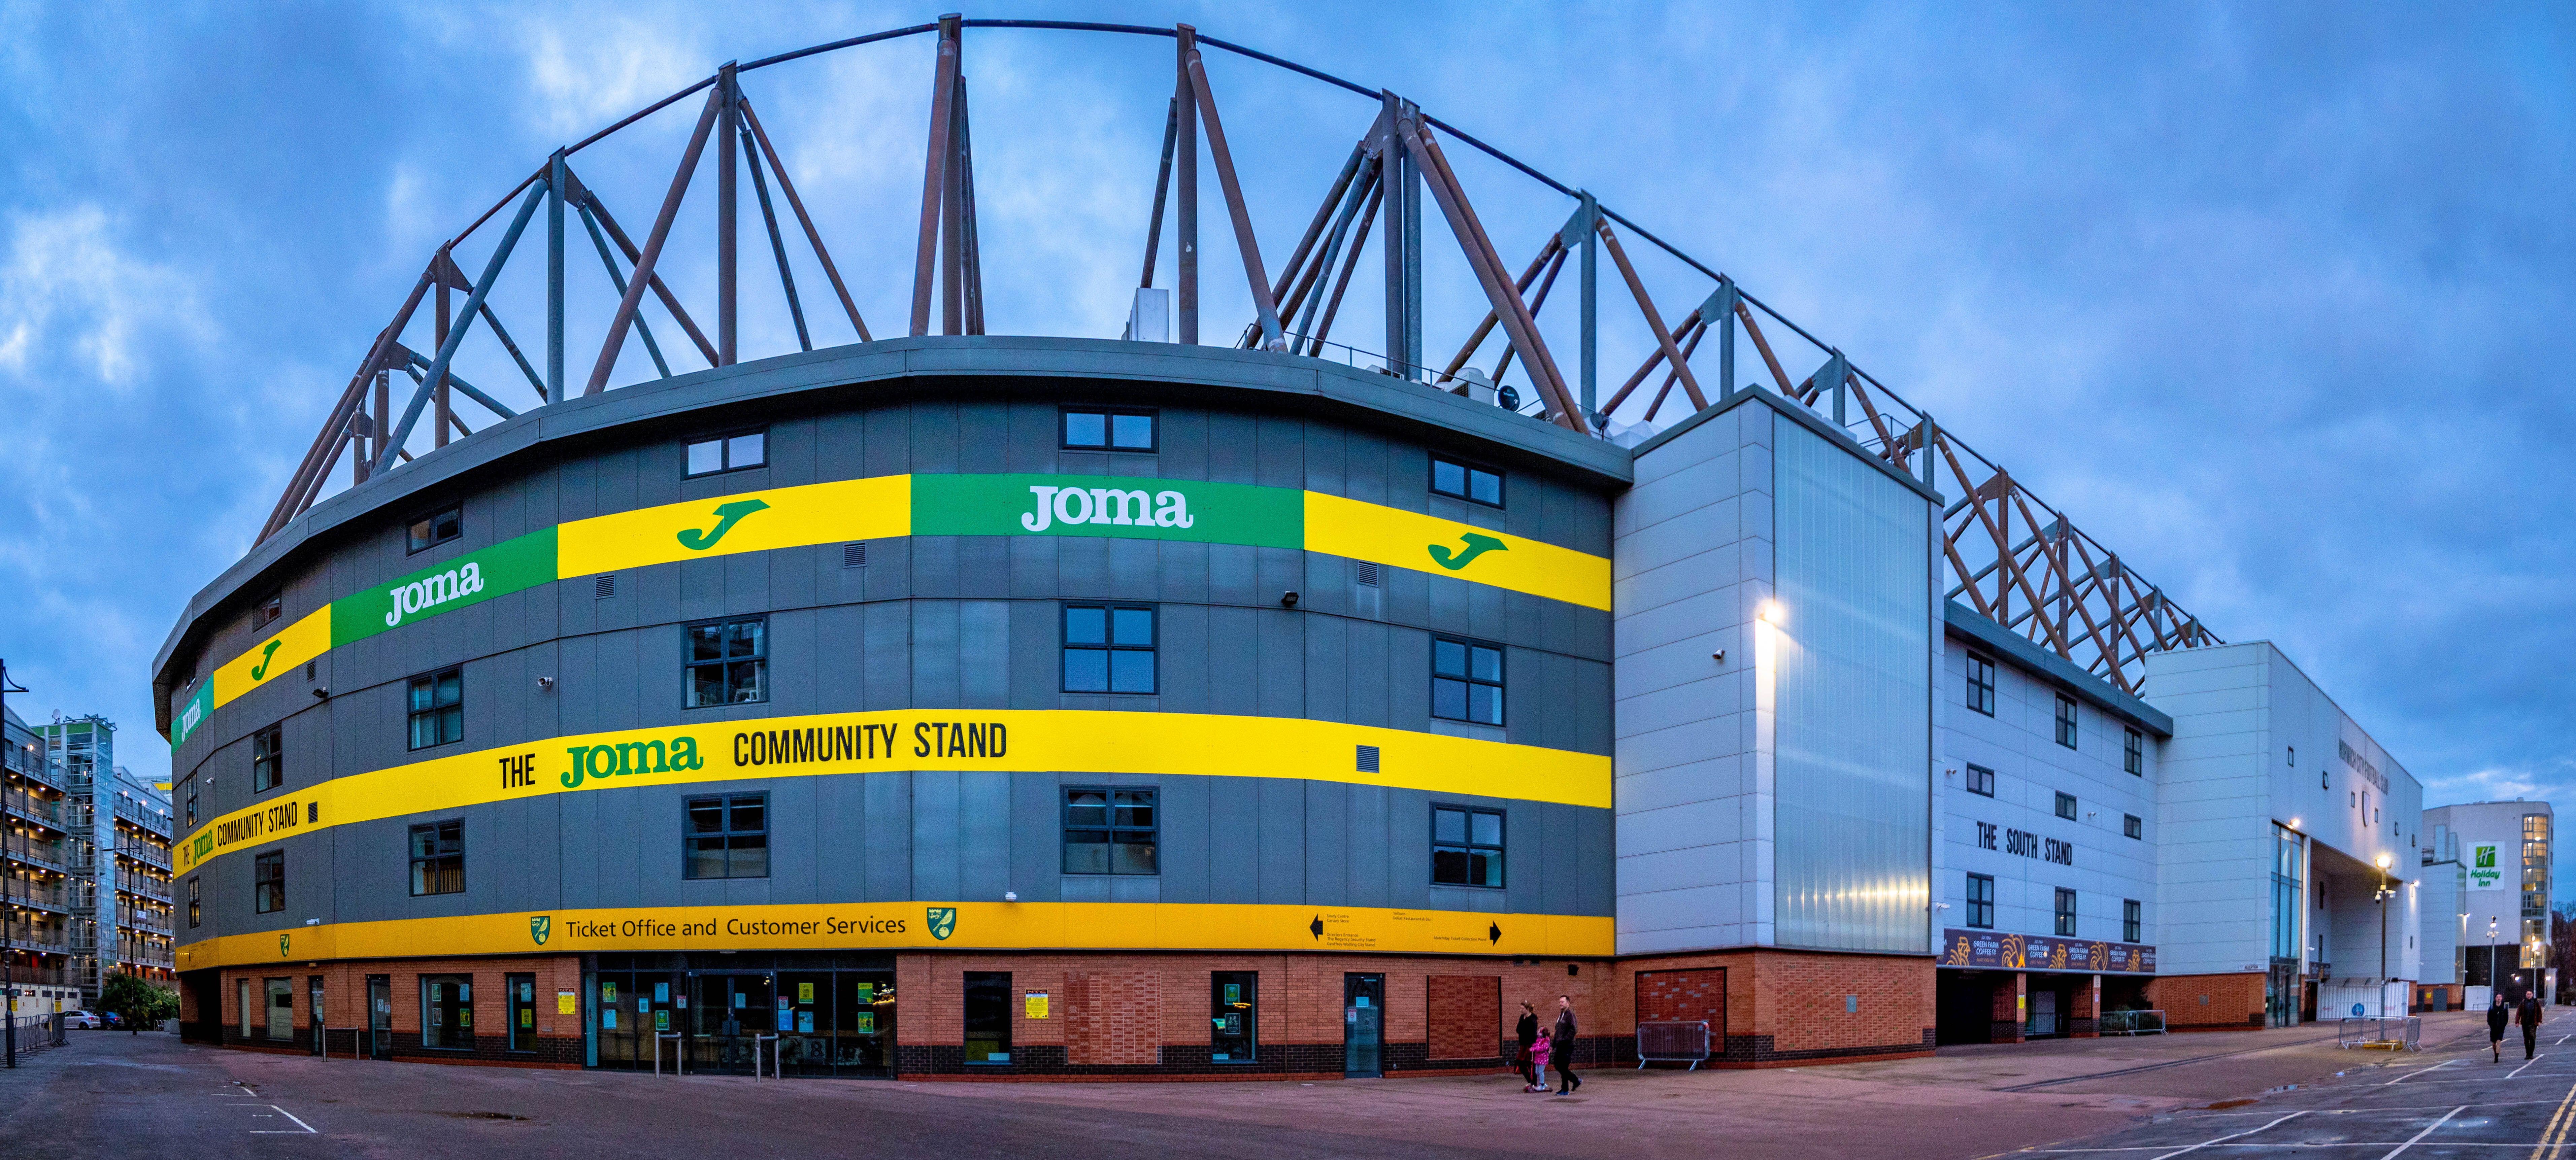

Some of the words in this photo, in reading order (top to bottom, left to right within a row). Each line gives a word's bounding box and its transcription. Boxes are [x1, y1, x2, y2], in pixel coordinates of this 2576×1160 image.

[1022, 485, 1194, 532] Joma
[386, 562, 484, 626] Joma
[499, 753, 535, 789] THE
[561, 736, 704, 788] Joma
[734, 723, 897, 766] COMMUNITY
[914, 722, 1007, 757] STAND
[218, 811, 264, 847] COMMUNITY
[269, 801, 297, 832] STAND
[1977, 821, 1997, 851] THE
[2007, 827, 2037, 859] SOUTH
[2045, 837, 2072, 866] STAND
[2471, 869, 2500, 880] Holiday
[2478, 878, 2490, 887] Inn
[566, 920, 616, 937] Ticket
[622, 919, 675, 936] Office
[682, 918, 716, 936] and
[727, 918, 820, 935] Customer
[826, 916, 906, 934] Services
